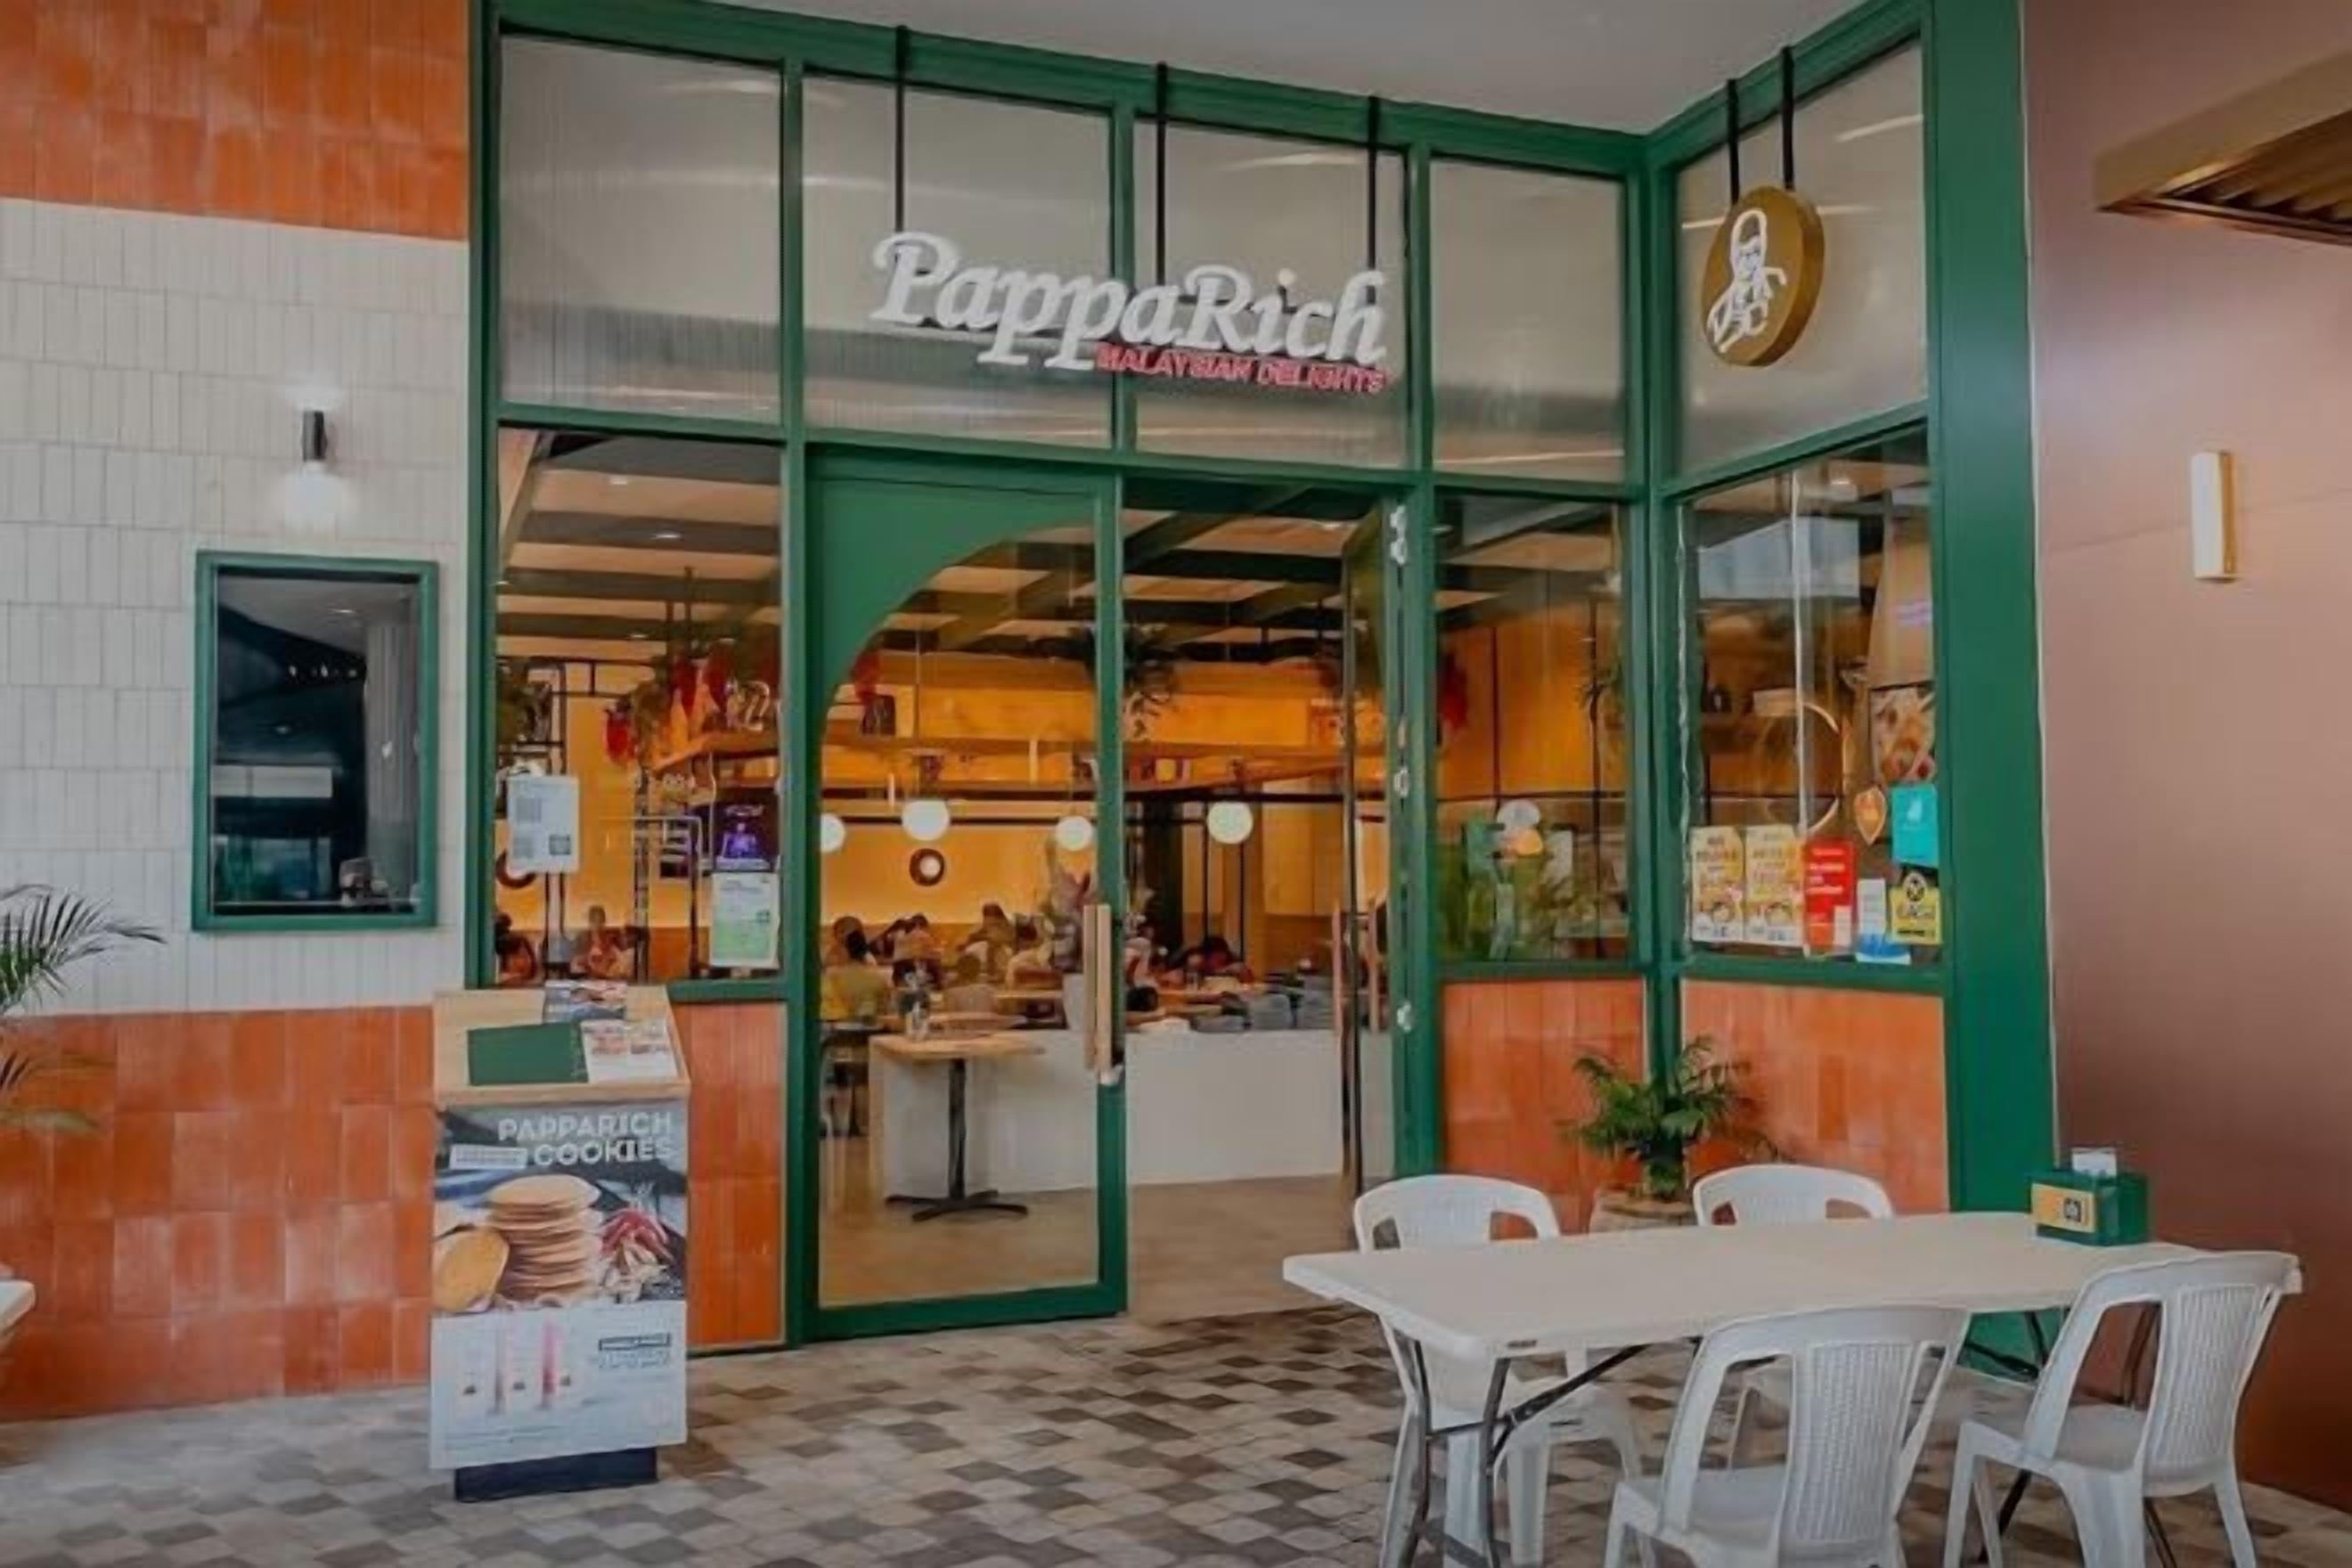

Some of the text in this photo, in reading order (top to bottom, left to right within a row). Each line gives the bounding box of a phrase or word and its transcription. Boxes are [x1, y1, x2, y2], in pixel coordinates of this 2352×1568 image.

[870, 231, 1387, 371] PappaRich
[1095, 343, 1387, 393] MALAYSIAN DELIGHTS
[497, 1111, 672, 1142] PAPPARICH
[535, 1134, 673, 1166] COOKIES
